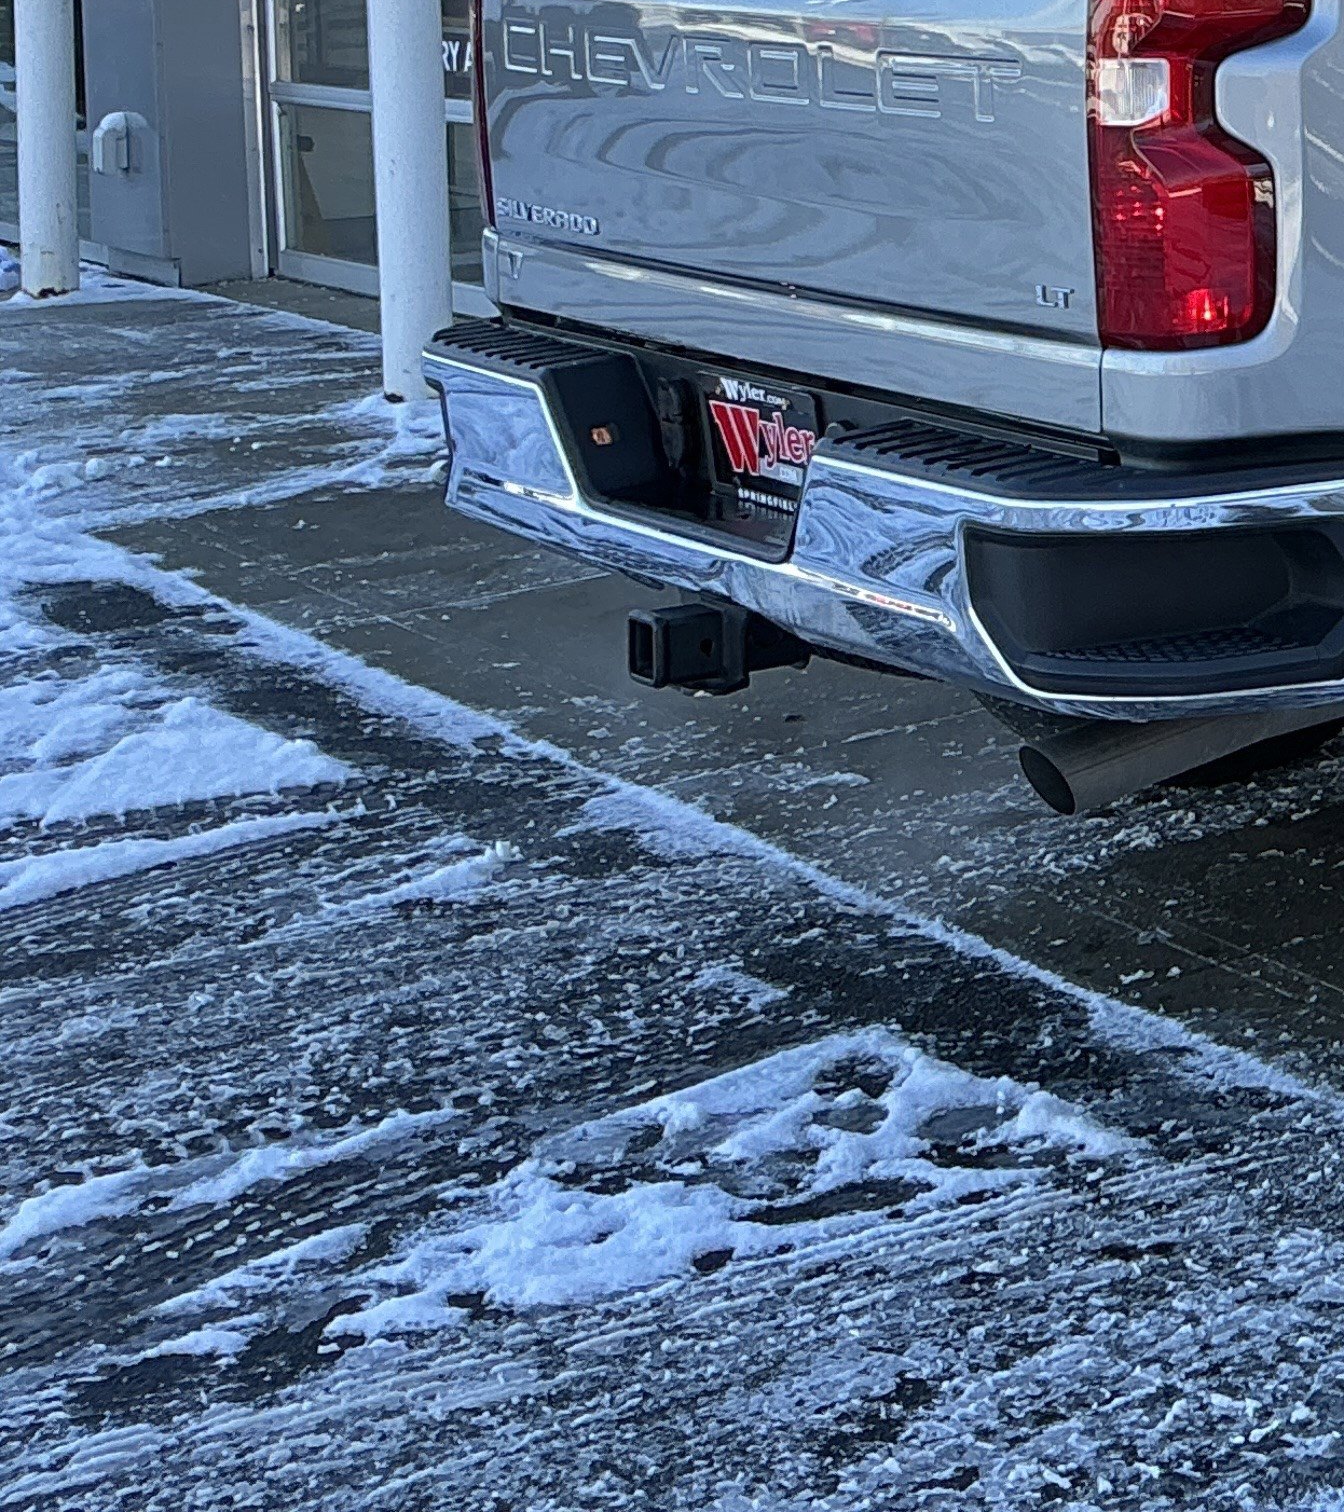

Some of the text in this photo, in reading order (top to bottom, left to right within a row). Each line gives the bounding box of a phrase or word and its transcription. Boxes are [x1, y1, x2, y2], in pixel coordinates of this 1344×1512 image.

[502, 16, 1021, 123] CHEVROLET
[496, 197, 600, 236] SILVERADO
[1035, 284, 1075, 309] LT
[709, 399, 815, 476] Wyler
